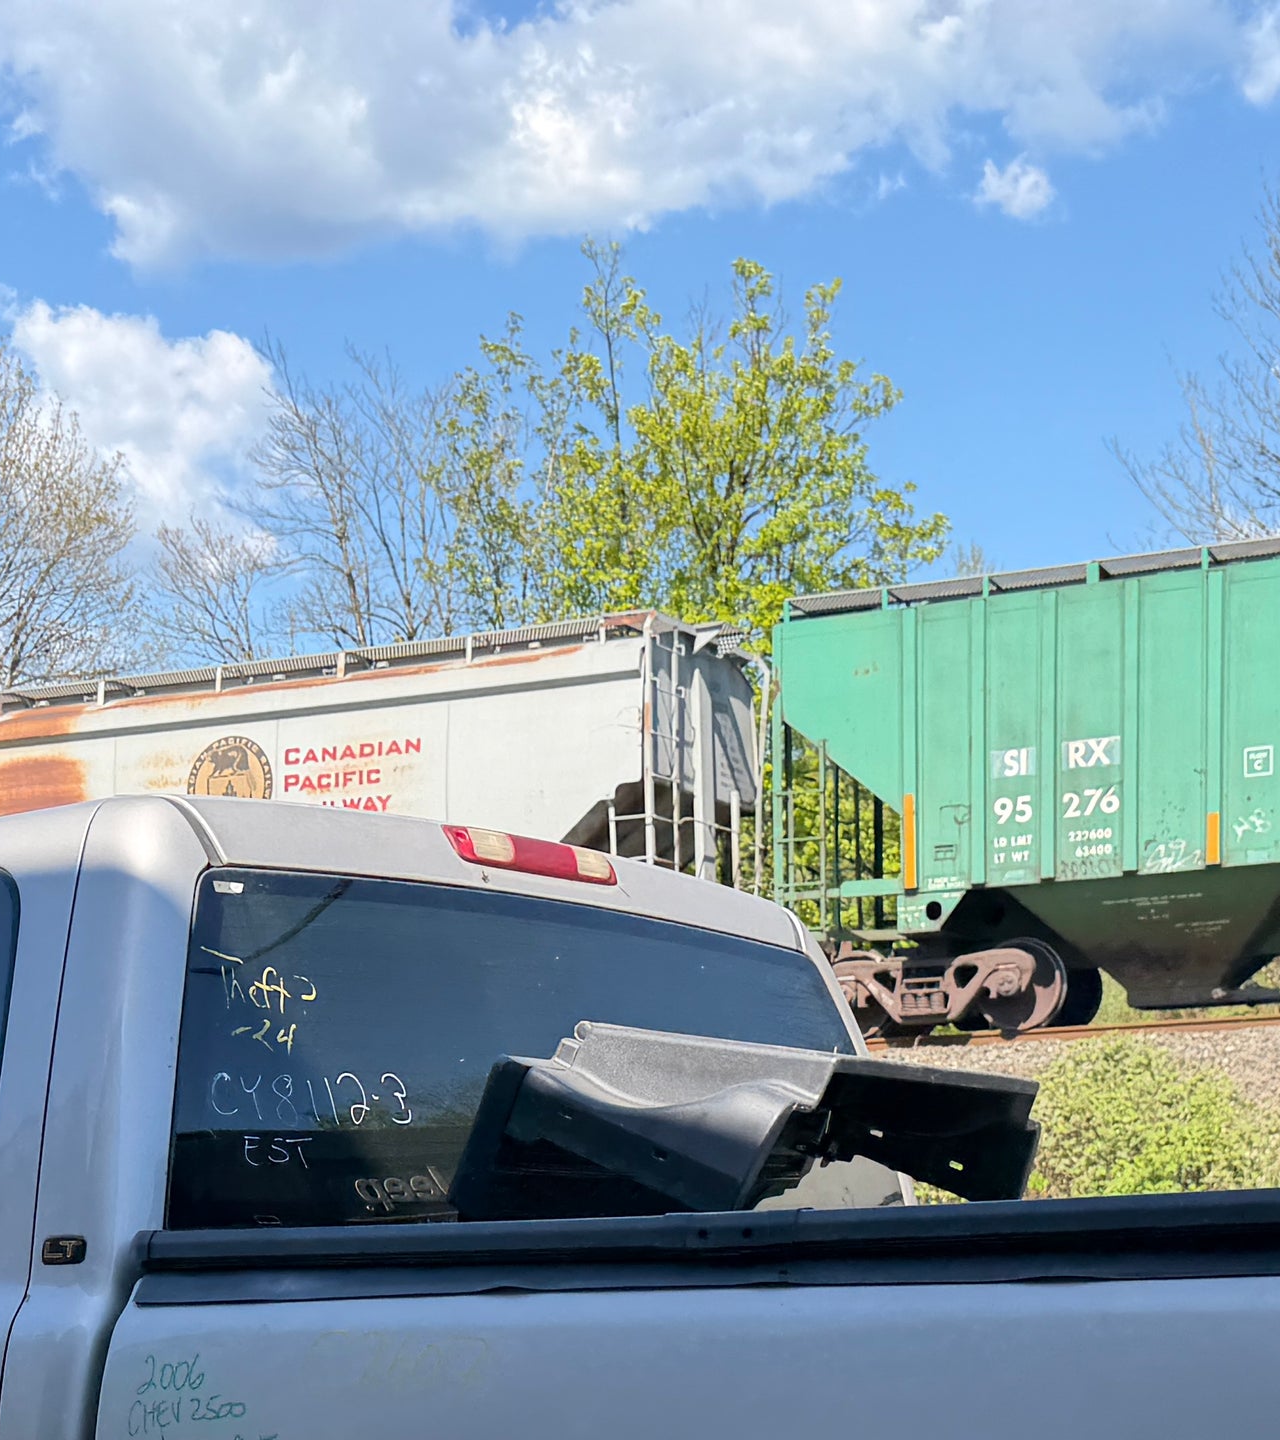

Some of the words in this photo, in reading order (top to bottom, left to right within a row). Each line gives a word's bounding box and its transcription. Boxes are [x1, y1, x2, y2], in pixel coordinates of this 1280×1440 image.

[284, 737, 422, 766] CANADIAN
[1003, 748, 1028, 777] SI
[1069, 739, 1111, 769] RX
[284, 768, 381, 793] PACIFIC
[994, 795, 1033, 825] 95
[1062, 785, 1120, 819] 276
[1011, 850, 1030, 862] WT
[243, 1135, 313, 1169] EST
[43, 1239, 83, 1259] LT
[136, 1353, 205, 1396] 2006
[128, 1397, 182, 1437] CHEV
[190, 1394, 247, 1421] 2500
